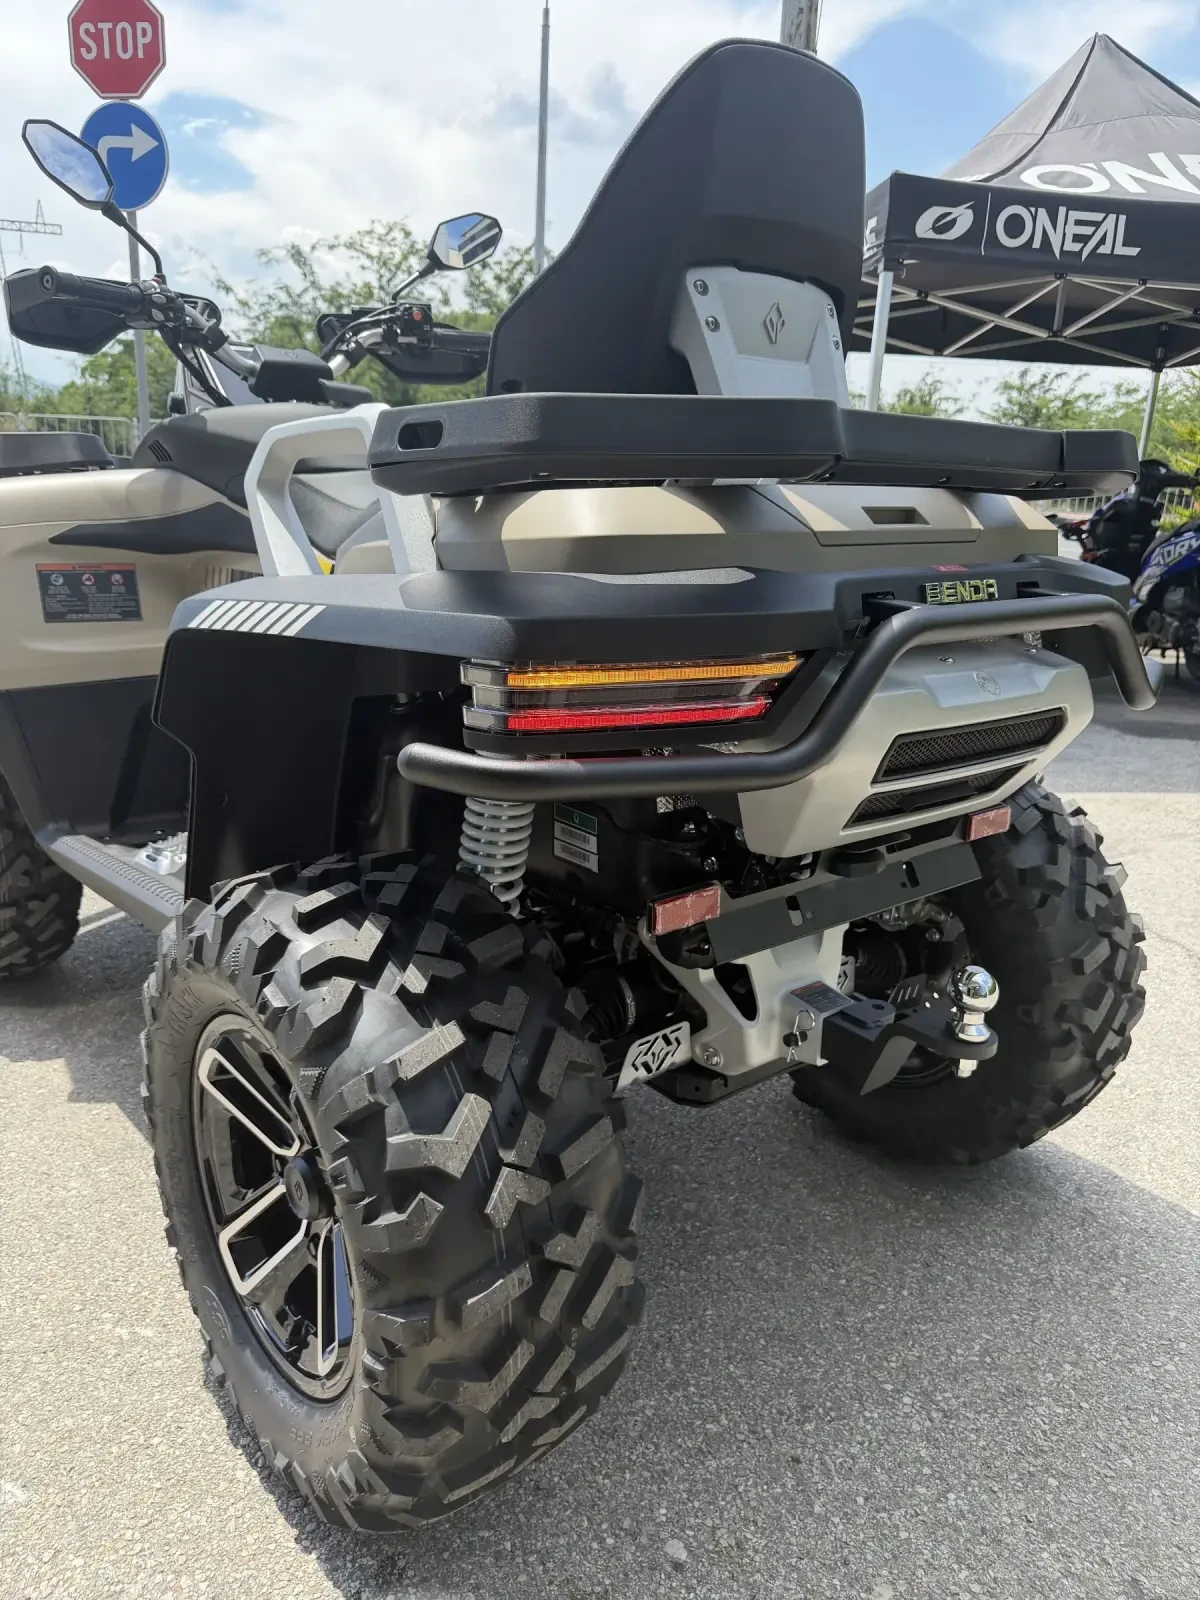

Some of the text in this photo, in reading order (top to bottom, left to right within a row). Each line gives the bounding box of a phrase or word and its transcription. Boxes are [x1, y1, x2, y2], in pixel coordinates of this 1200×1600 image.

[79, 21, 153, 60] STOP
[995, 204, 1141, 262] O'NEAL
[925, 578, 999, 605] BENDA
